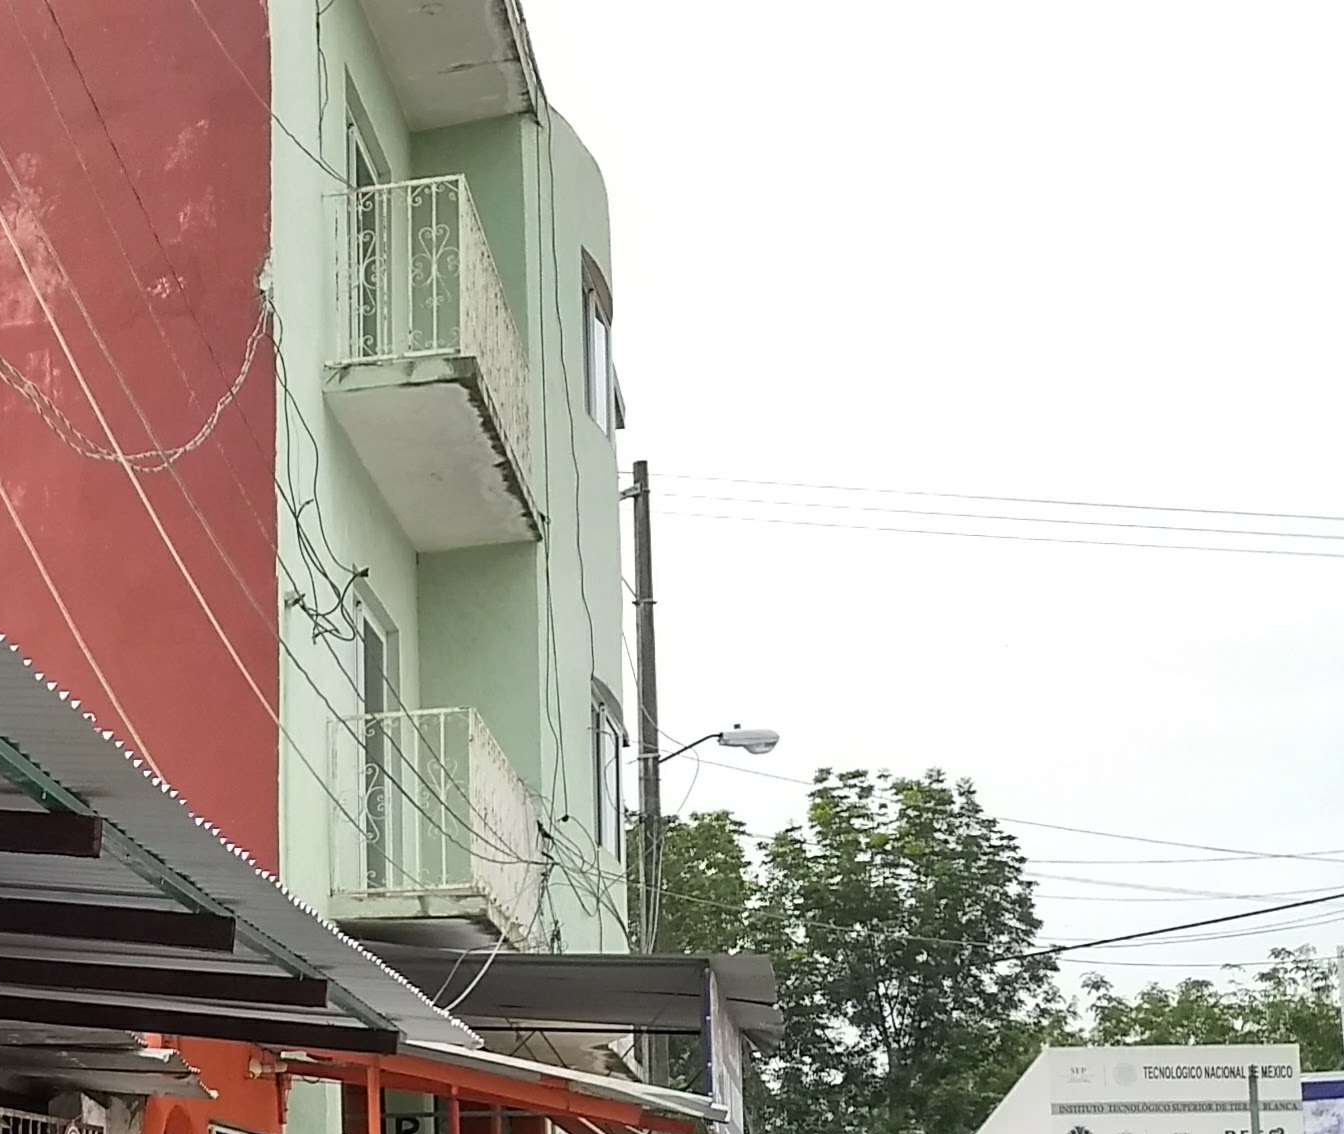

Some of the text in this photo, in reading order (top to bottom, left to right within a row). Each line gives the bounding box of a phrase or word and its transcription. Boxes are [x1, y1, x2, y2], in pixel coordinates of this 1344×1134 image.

[1204, 1065, 1246, 1080] NACIONAL
[1059, 1104, 1104, 1114] INSTITUTO
[1172, 1103, 1213, 1113] SUPERIOR
[1215, 1103, 1228, 1112] DE
[1262, 1102, 1299, 1111] BLANCA
